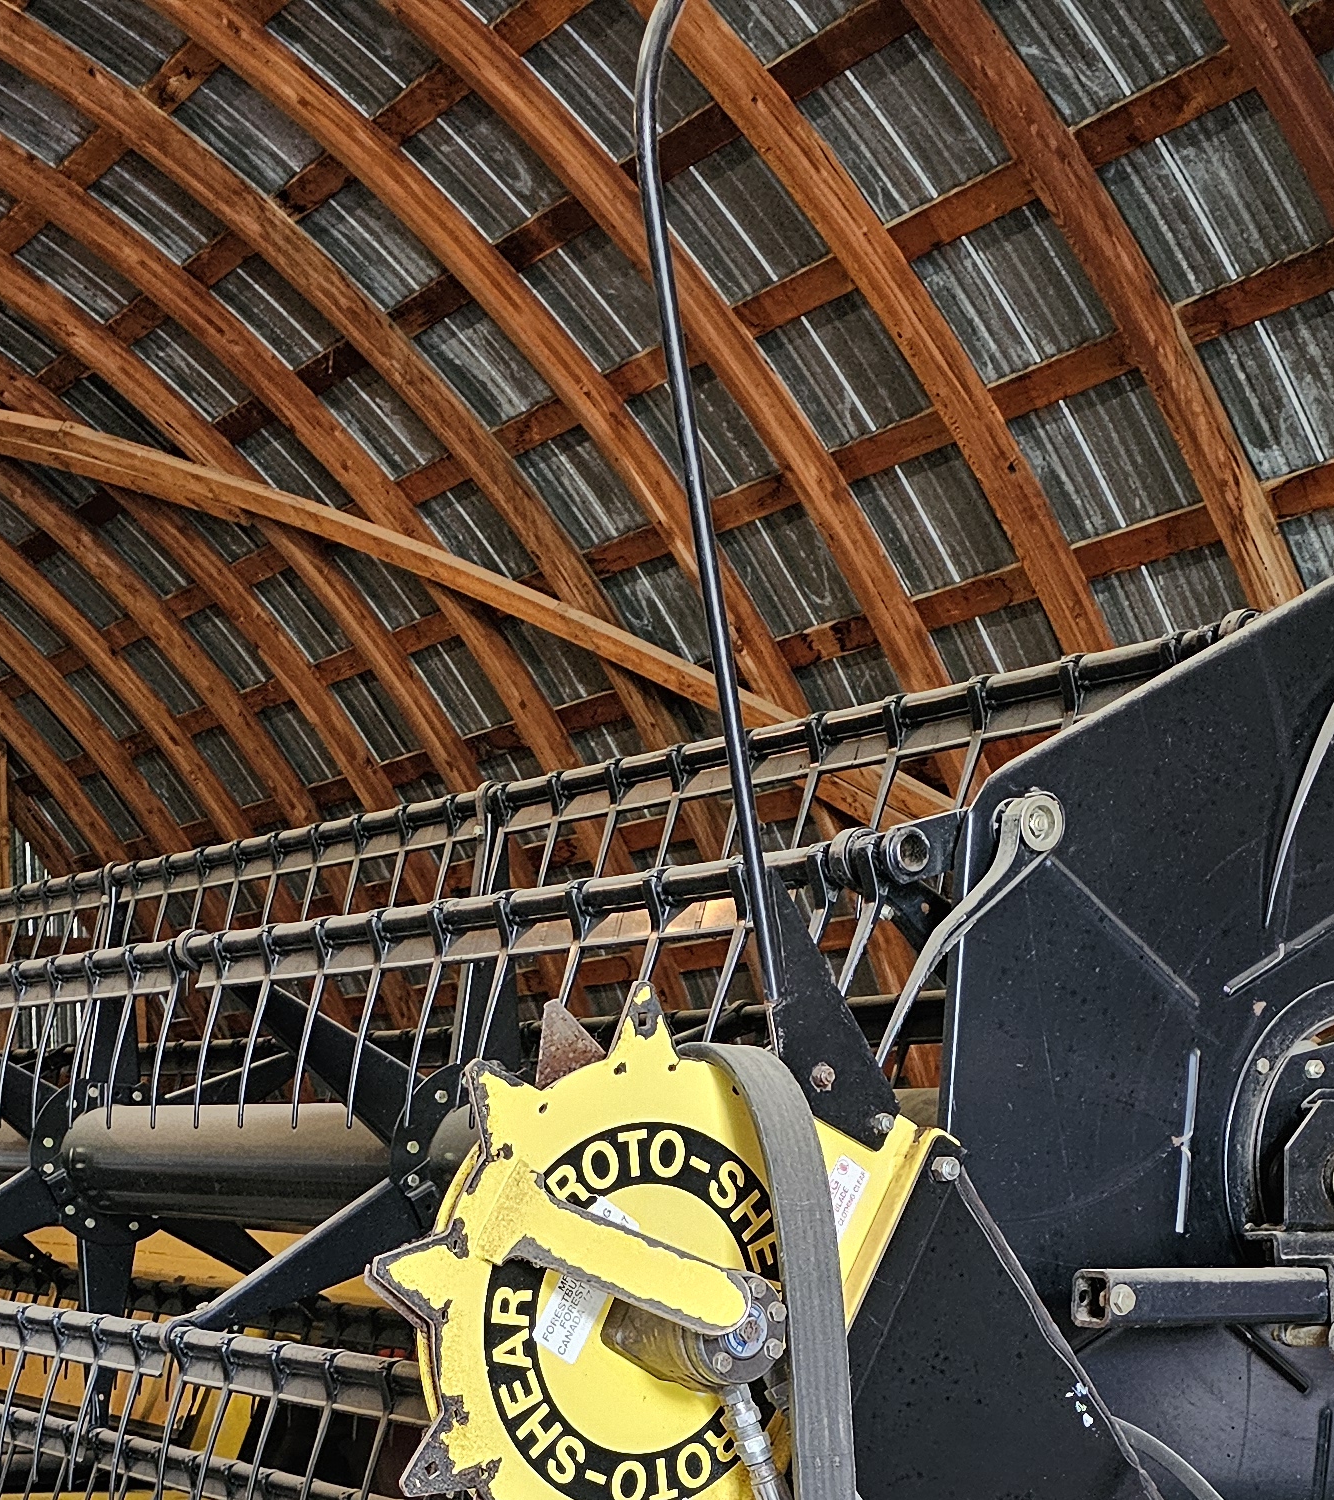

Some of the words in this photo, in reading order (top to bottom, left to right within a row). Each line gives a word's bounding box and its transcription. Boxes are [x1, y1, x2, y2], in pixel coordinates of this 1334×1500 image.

[545, 1128, 781, 1278] ROTO-SHE
[541, 1279, 577, 1342] FORESTBU
[557, 1309, 585, 1356] CANADA
[560, 1283, 587, 1330] FOREST
